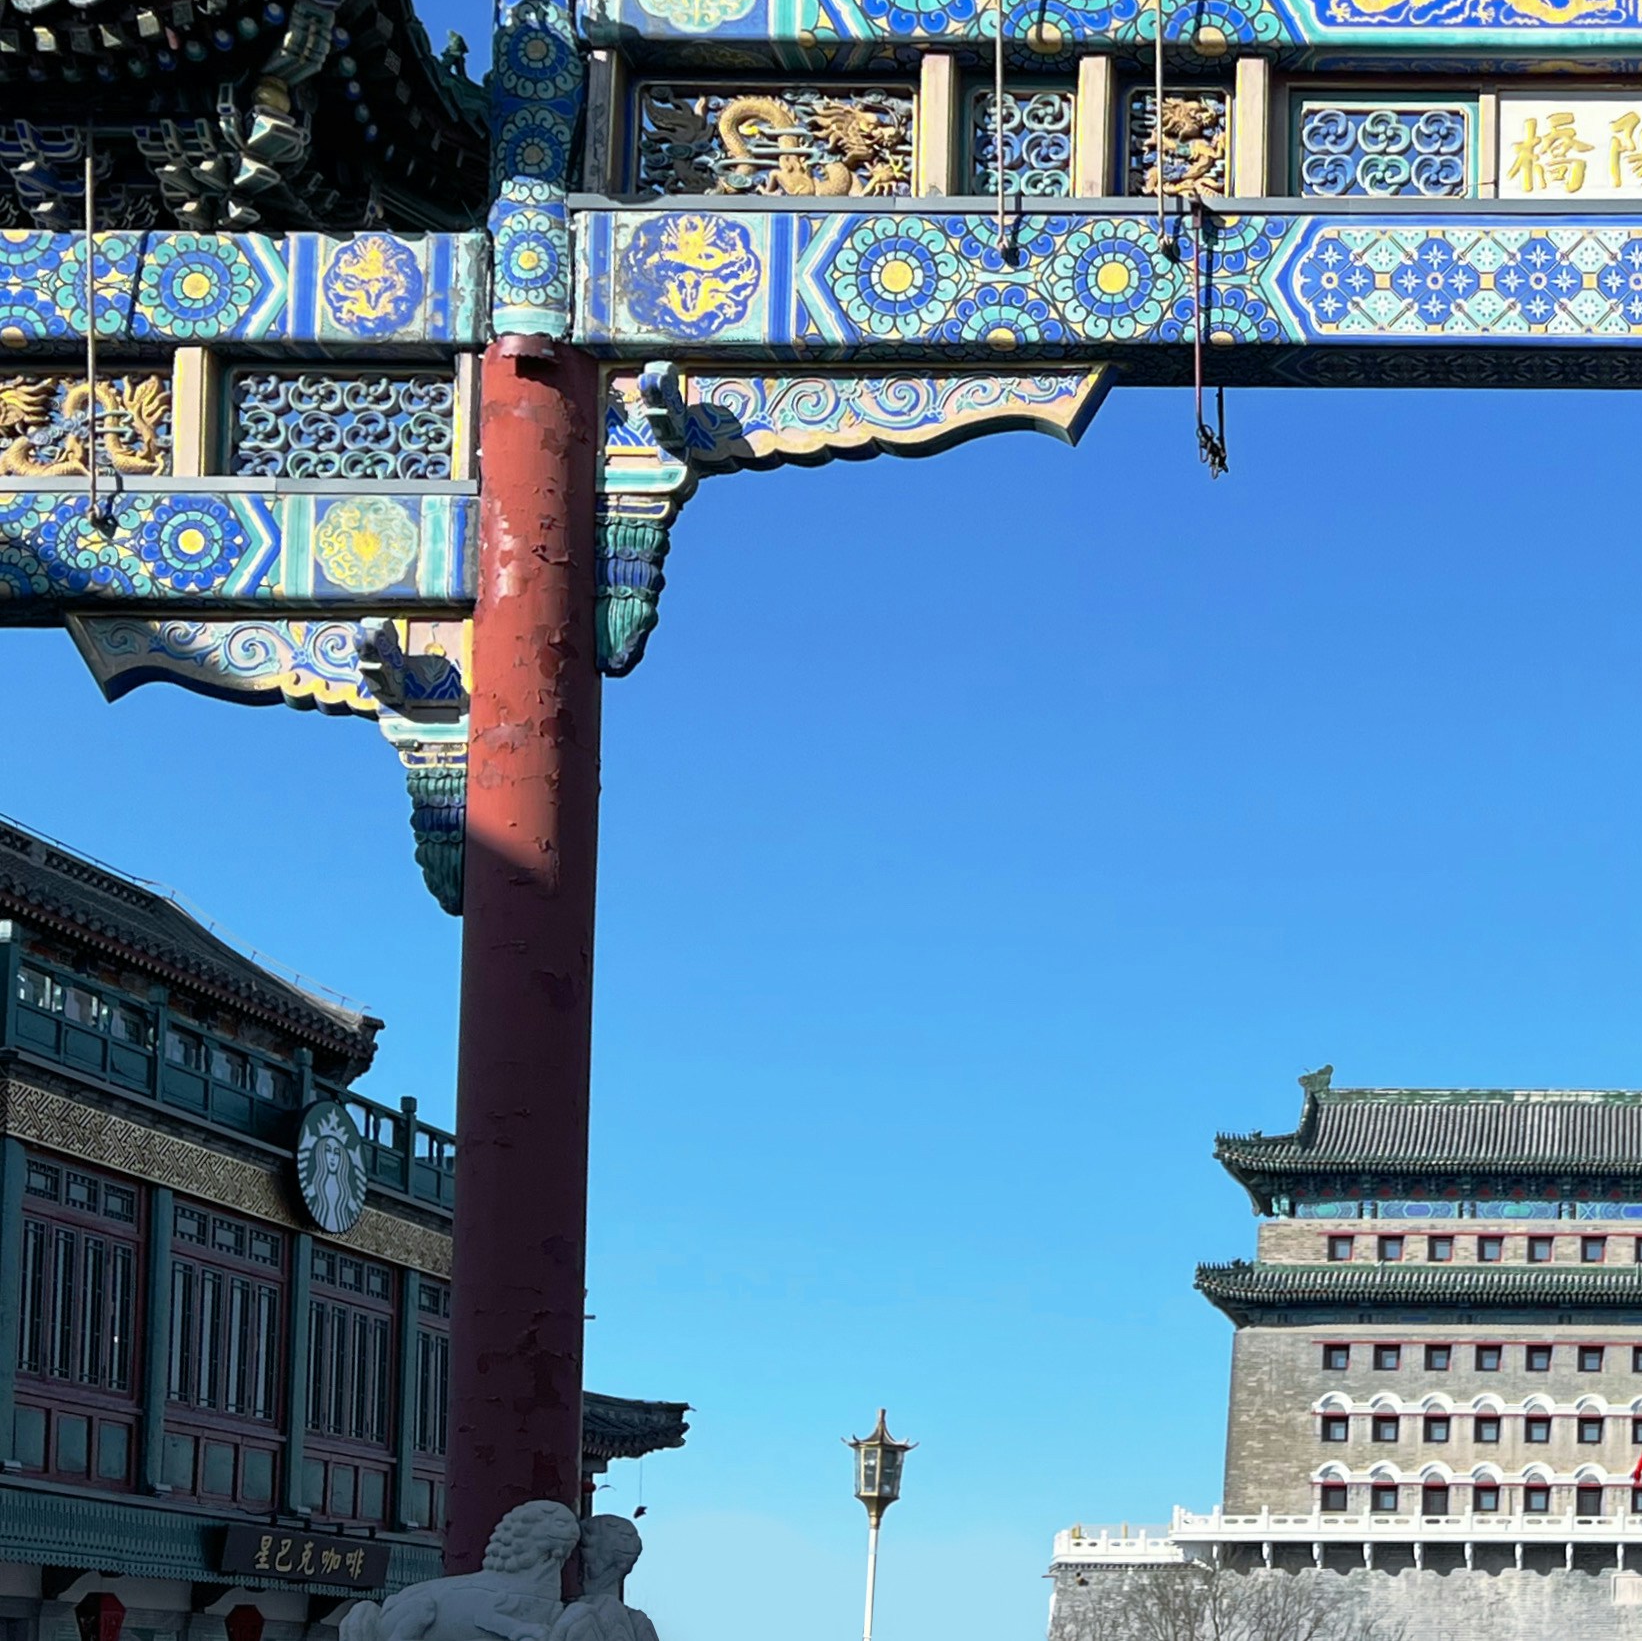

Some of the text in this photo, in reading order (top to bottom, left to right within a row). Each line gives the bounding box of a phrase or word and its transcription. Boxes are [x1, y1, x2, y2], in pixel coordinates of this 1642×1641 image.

[254, 1535, 365, 1580] 星巴克咖啡
